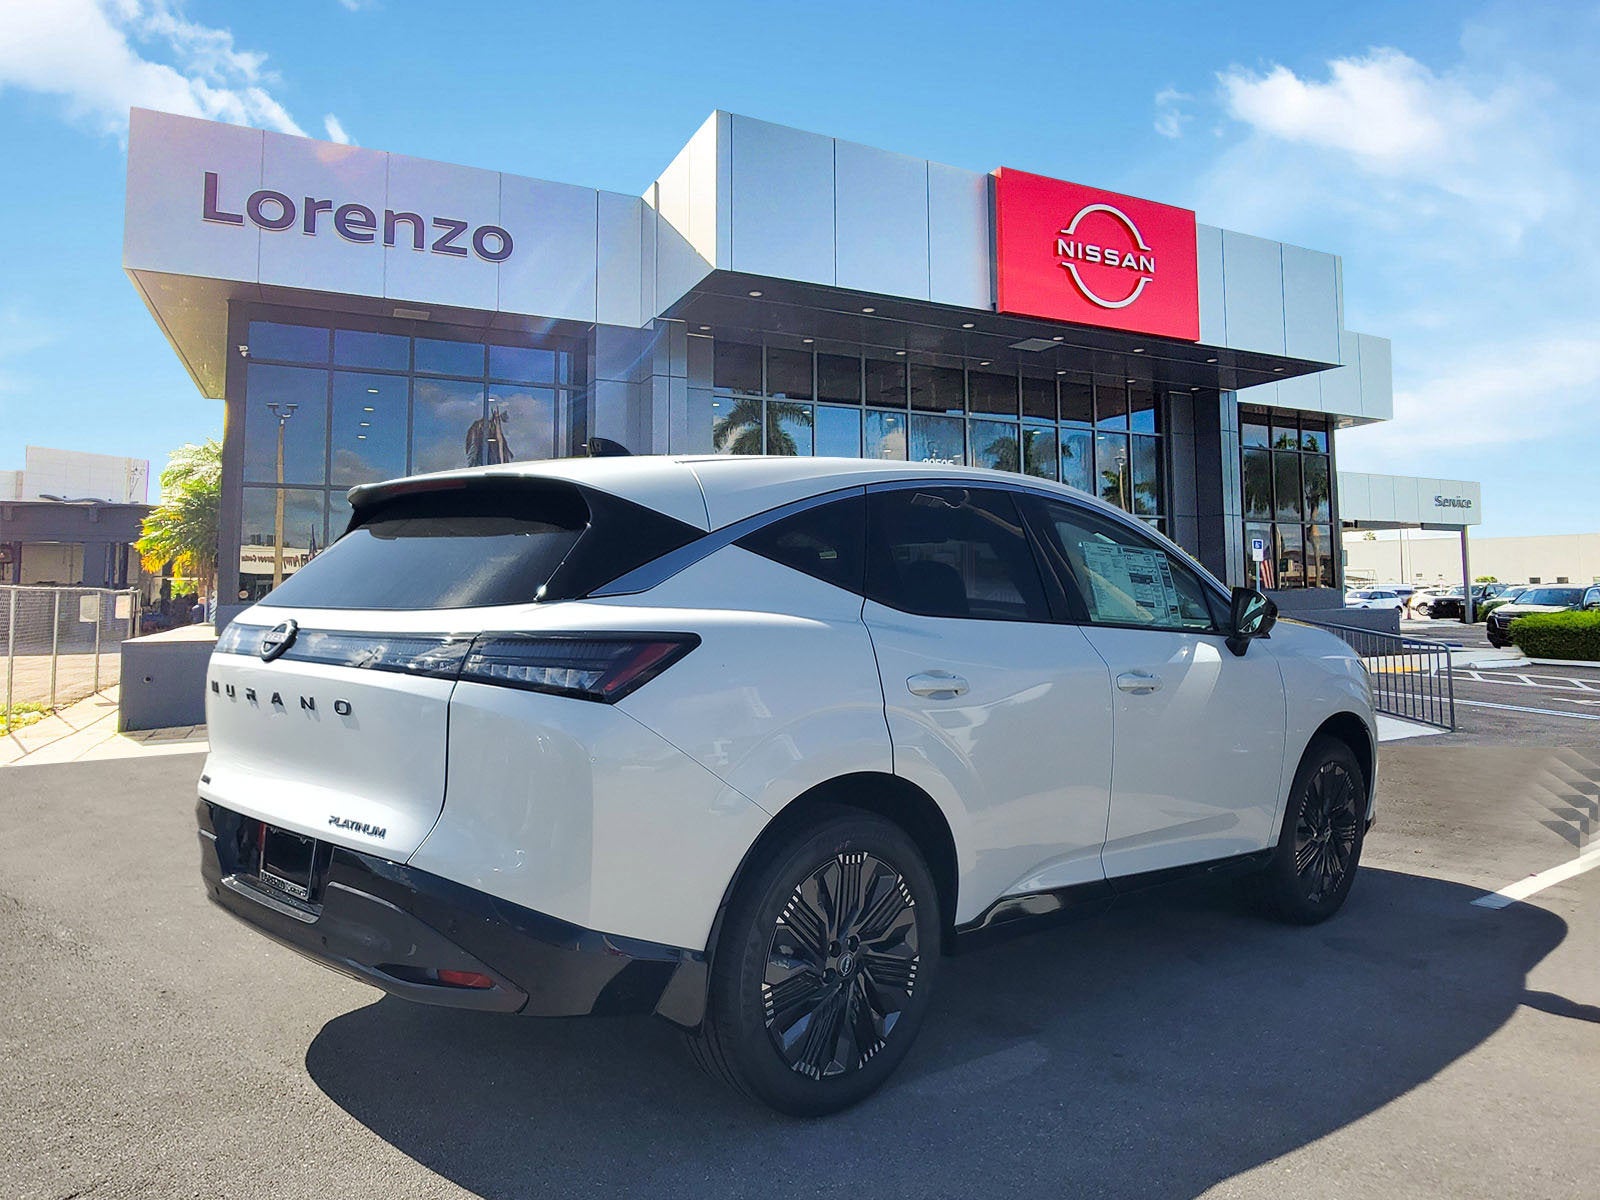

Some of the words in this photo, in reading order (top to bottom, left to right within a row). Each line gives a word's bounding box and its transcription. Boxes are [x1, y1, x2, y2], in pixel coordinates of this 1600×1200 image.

[203, 171, 514, 262] Lorenzo
[1057, 238, 1155, 273] NISSAN
[1434, 495, 1472, 509] Service
[211, 680, 352, 716] MURANO
[328, 815, 387, 840] PLATINUM
